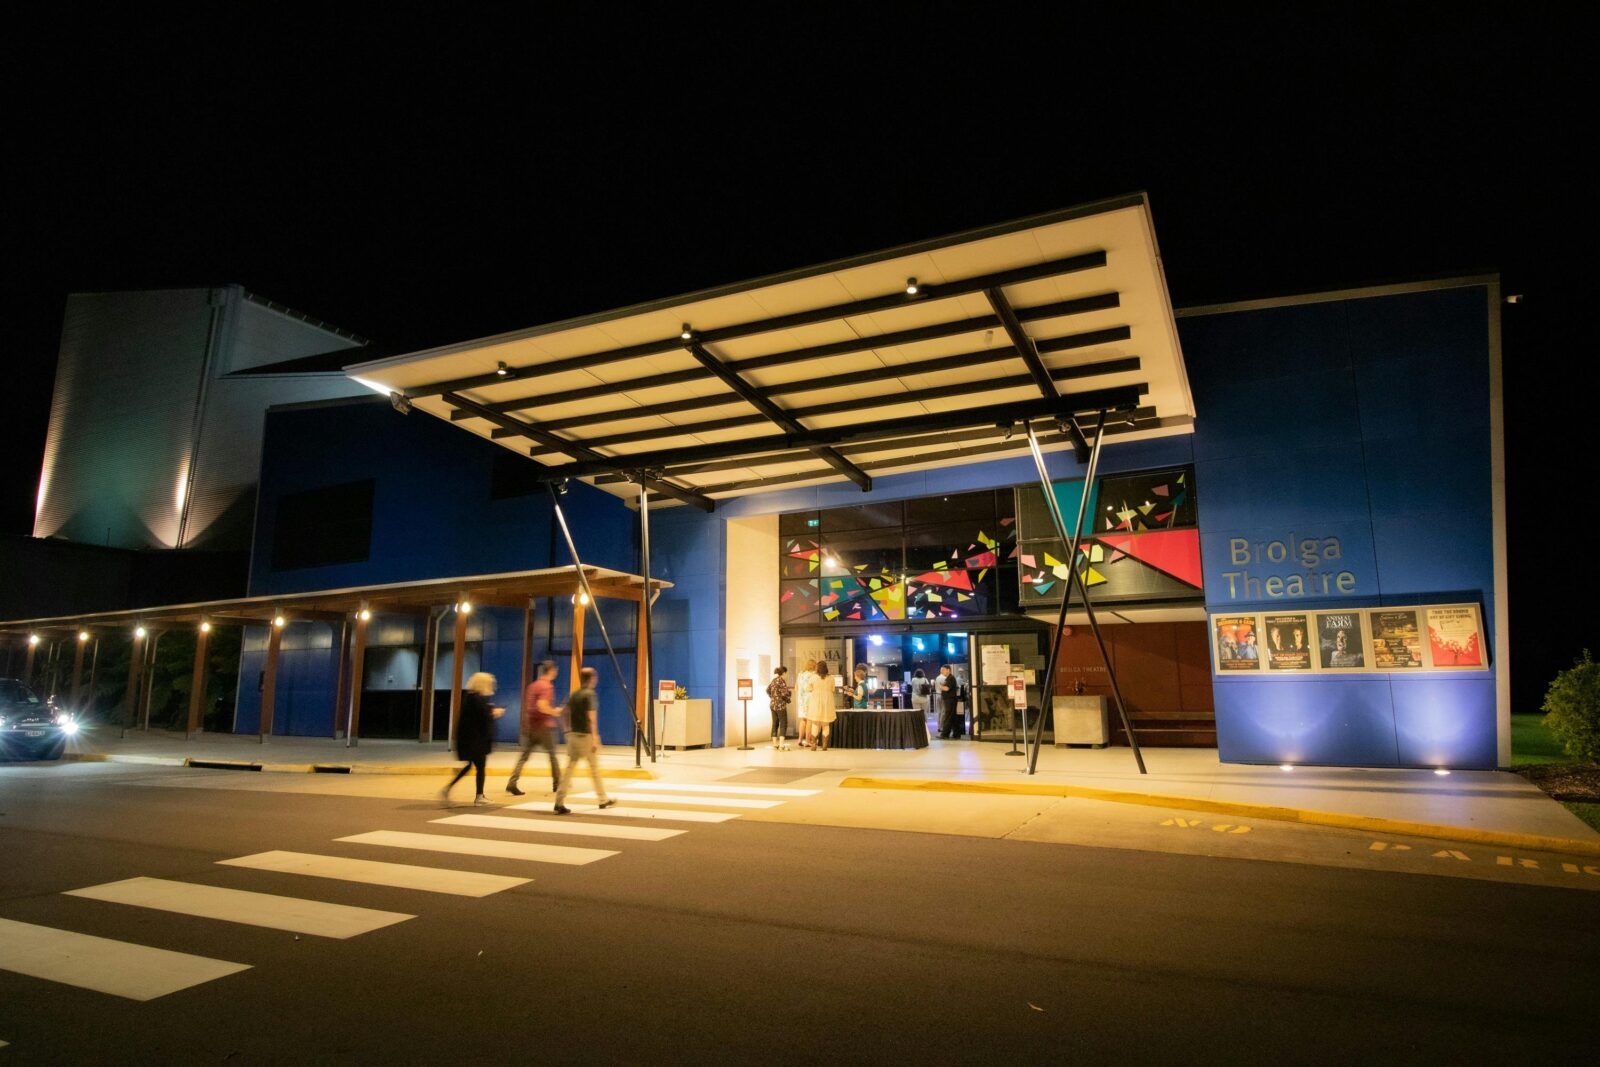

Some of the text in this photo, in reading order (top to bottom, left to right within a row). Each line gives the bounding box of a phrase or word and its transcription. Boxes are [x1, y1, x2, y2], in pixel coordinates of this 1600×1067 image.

[1230, 531, 1342, 568] Brolga
[1222, 568, 1356, 599] Theatre
[1160, 816, 1252, 833] NO
